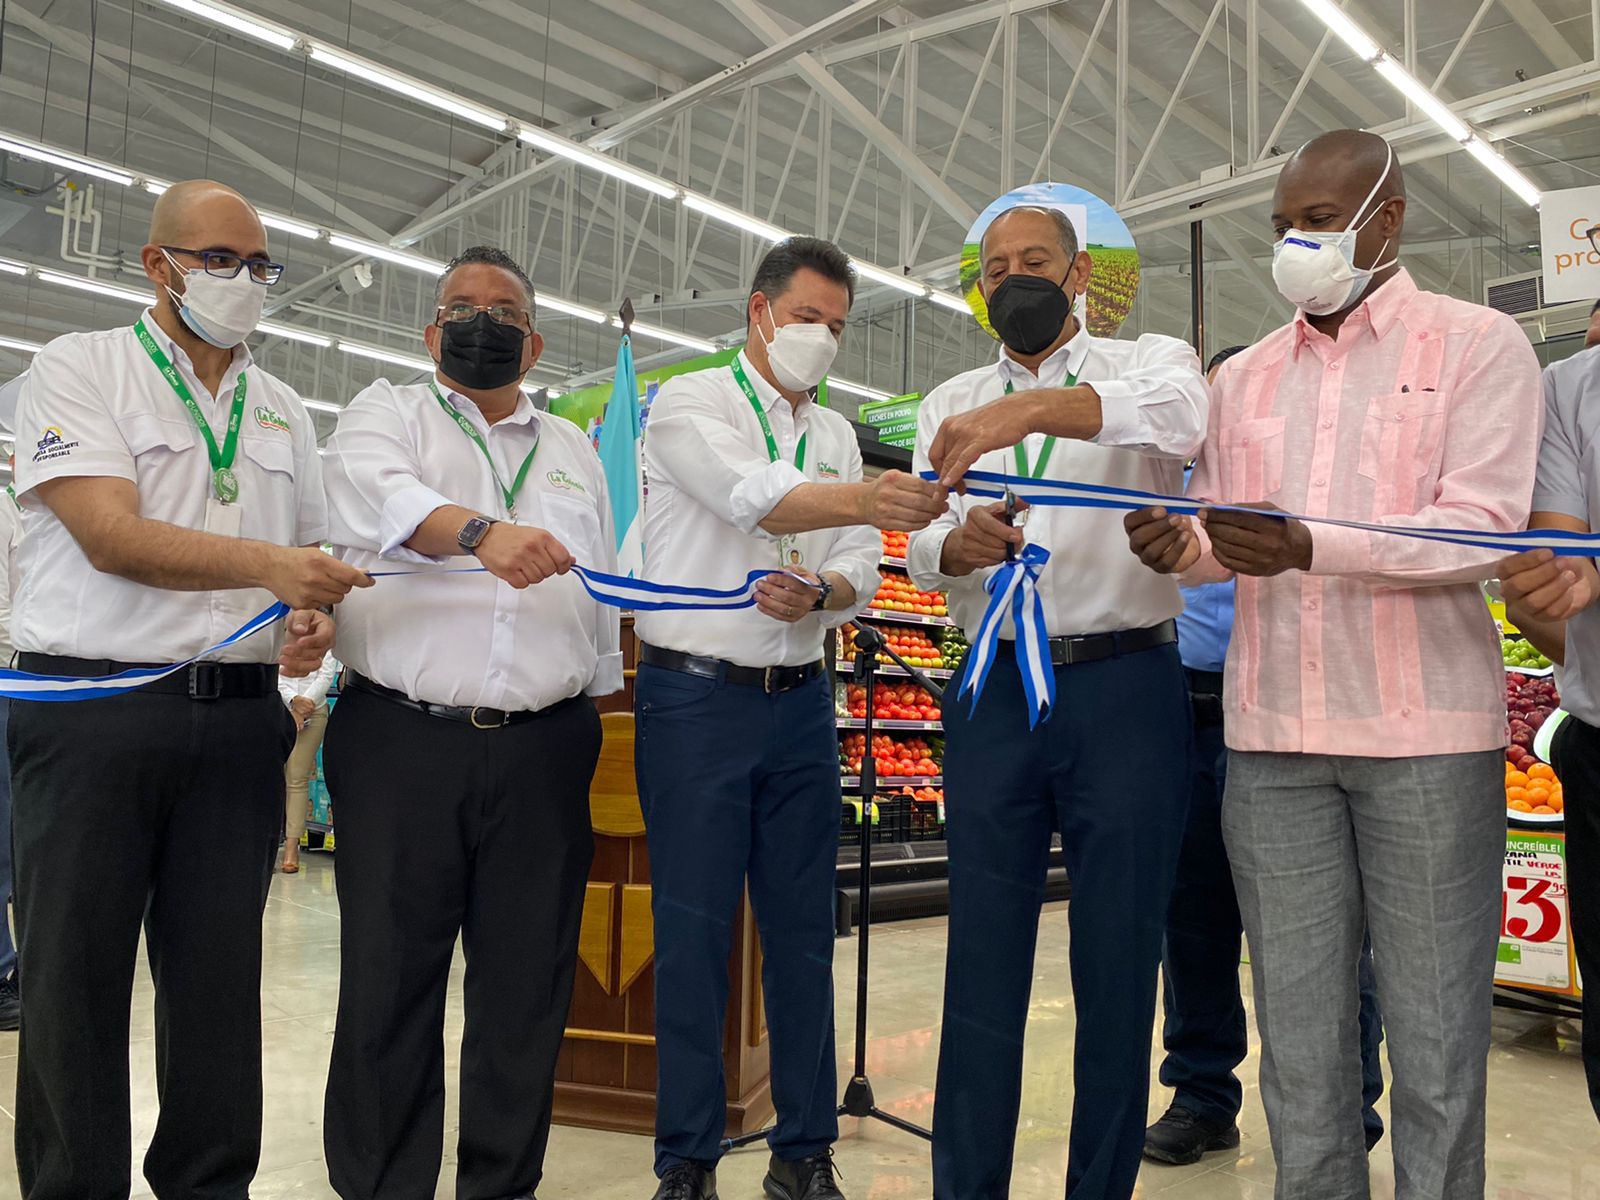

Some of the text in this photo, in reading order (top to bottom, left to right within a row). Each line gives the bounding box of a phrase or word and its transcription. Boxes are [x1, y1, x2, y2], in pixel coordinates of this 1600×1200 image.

[868, 412, 887, 423] LECHES
[895, 407, 912, 418] POLVO
[1506, 841, 1561, 853] INCREÍBLE!
[1504, 858, 1562, 870] TIL VERDE
